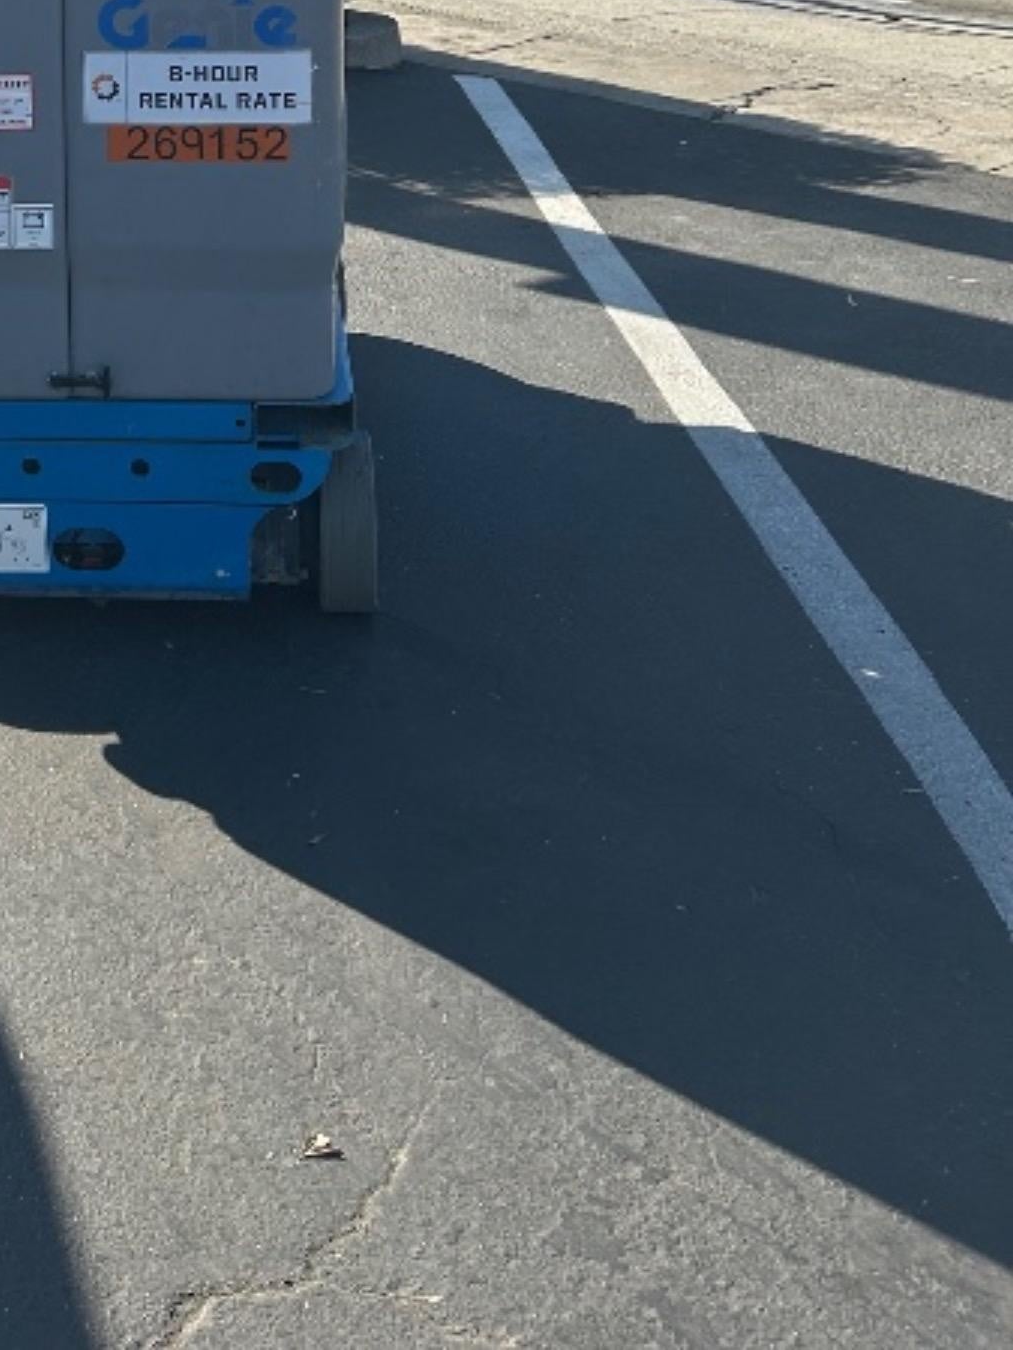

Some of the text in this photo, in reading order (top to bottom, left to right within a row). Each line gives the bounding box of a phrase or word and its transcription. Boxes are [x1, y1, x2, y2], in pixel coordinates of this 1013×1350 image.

[139, 92, 297, 109] RENTAL RATE
[126, 125, 288, 161] 269152
